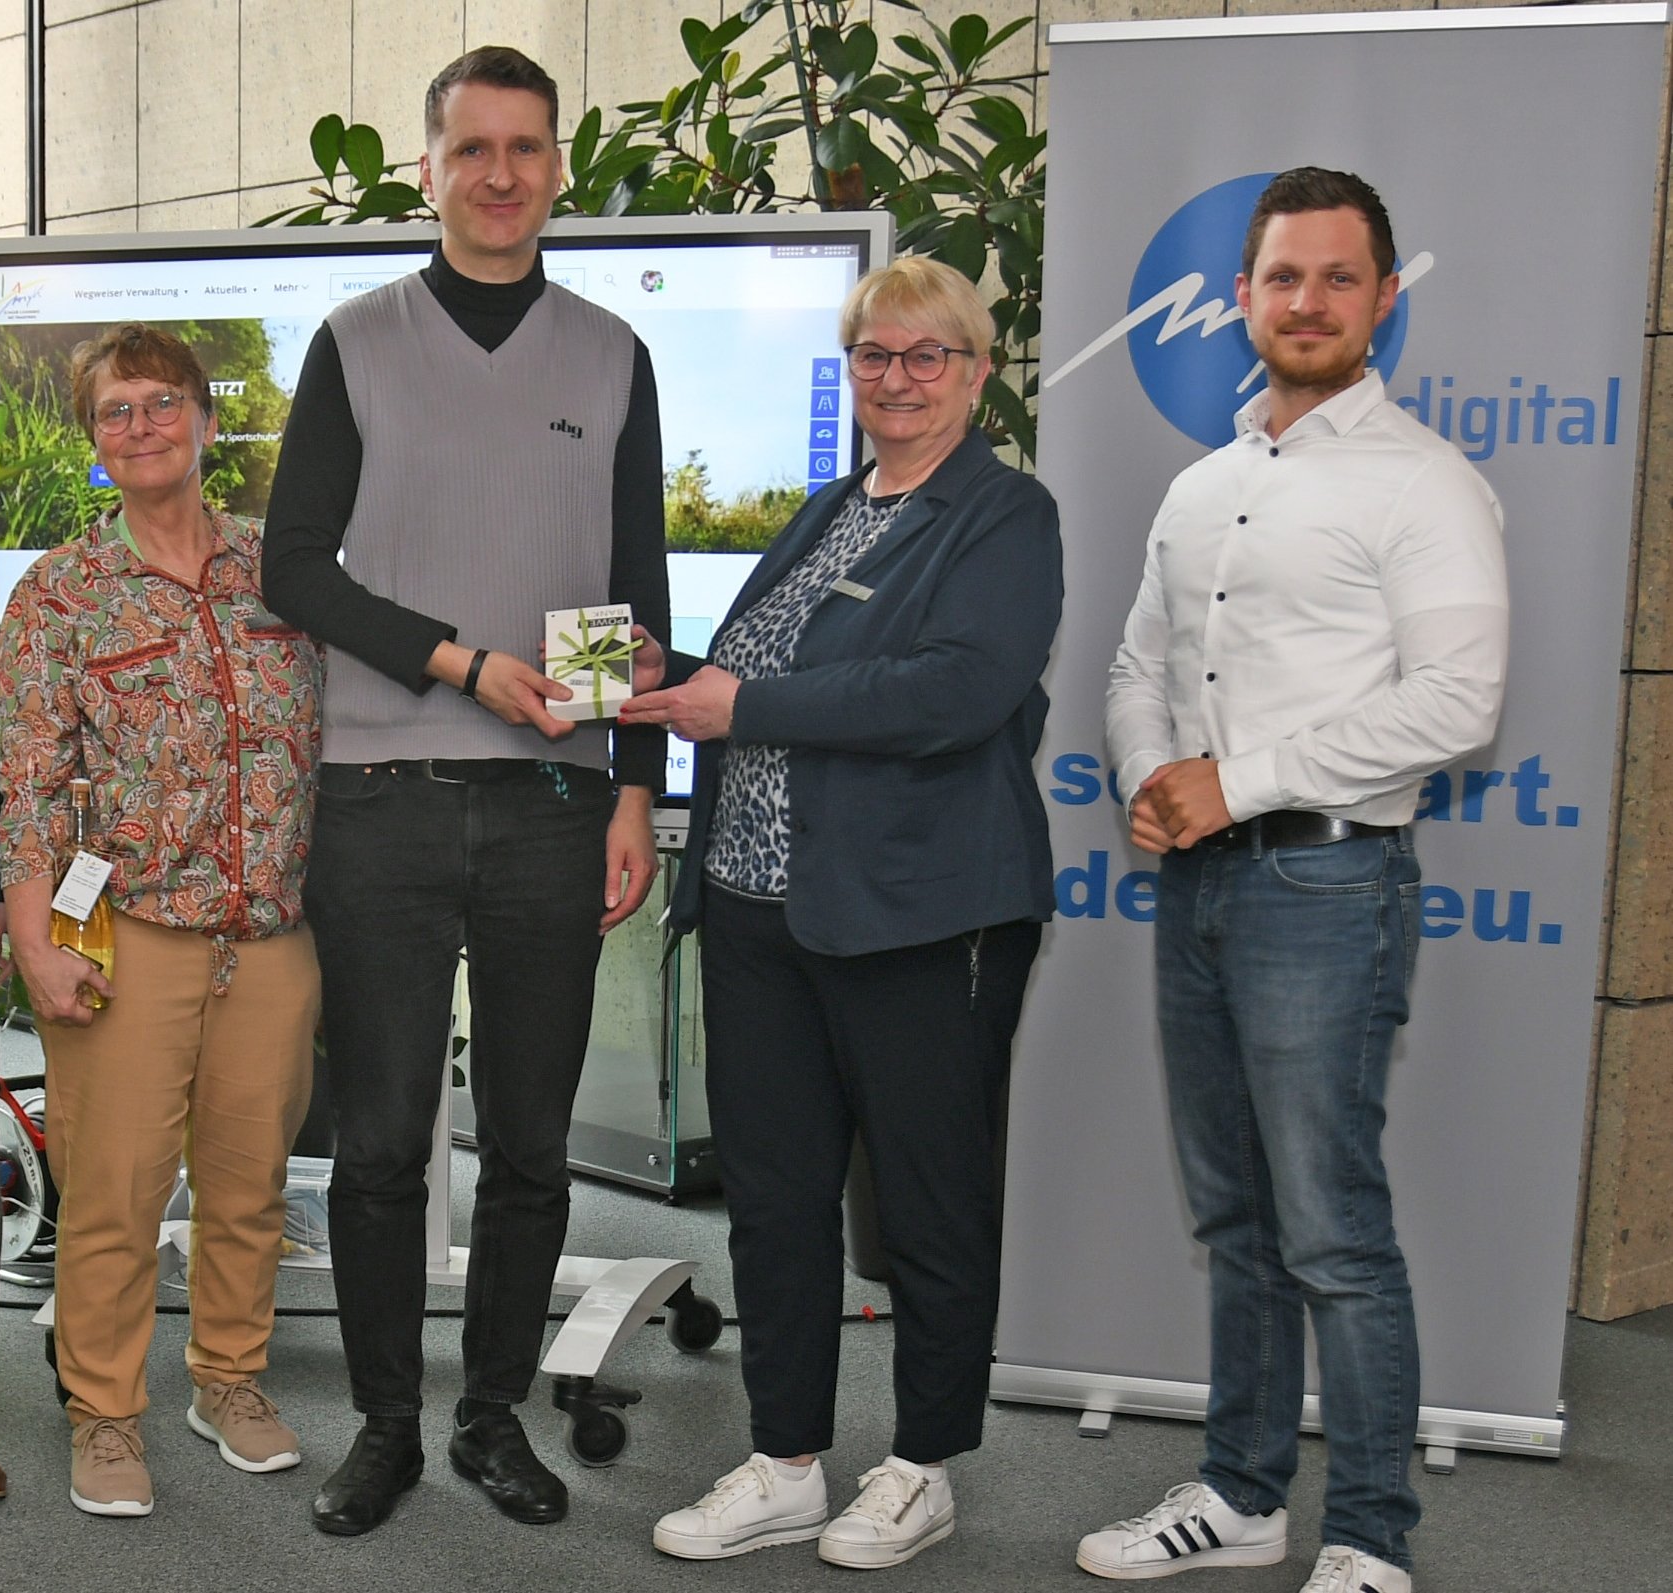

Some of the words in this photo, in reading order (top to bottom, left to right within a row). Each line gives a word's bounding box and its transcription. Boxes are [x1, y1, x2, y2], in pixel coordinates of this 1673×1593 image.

[74, 289, 123, 300] Wegweiser
[126, 287, 179, 298] Verwaltung
[204, 285, 247, 295] Aktuelles
[274, 283, 298, 292] Mehr
[209, 381, 246, 396] ETZT
[1395, 376, 1620, 461] digital
[583, 617, 625, 627] POWE
[1414, 753, 1580, 828] art.
[1420, 882, 1563, 944] eu.
